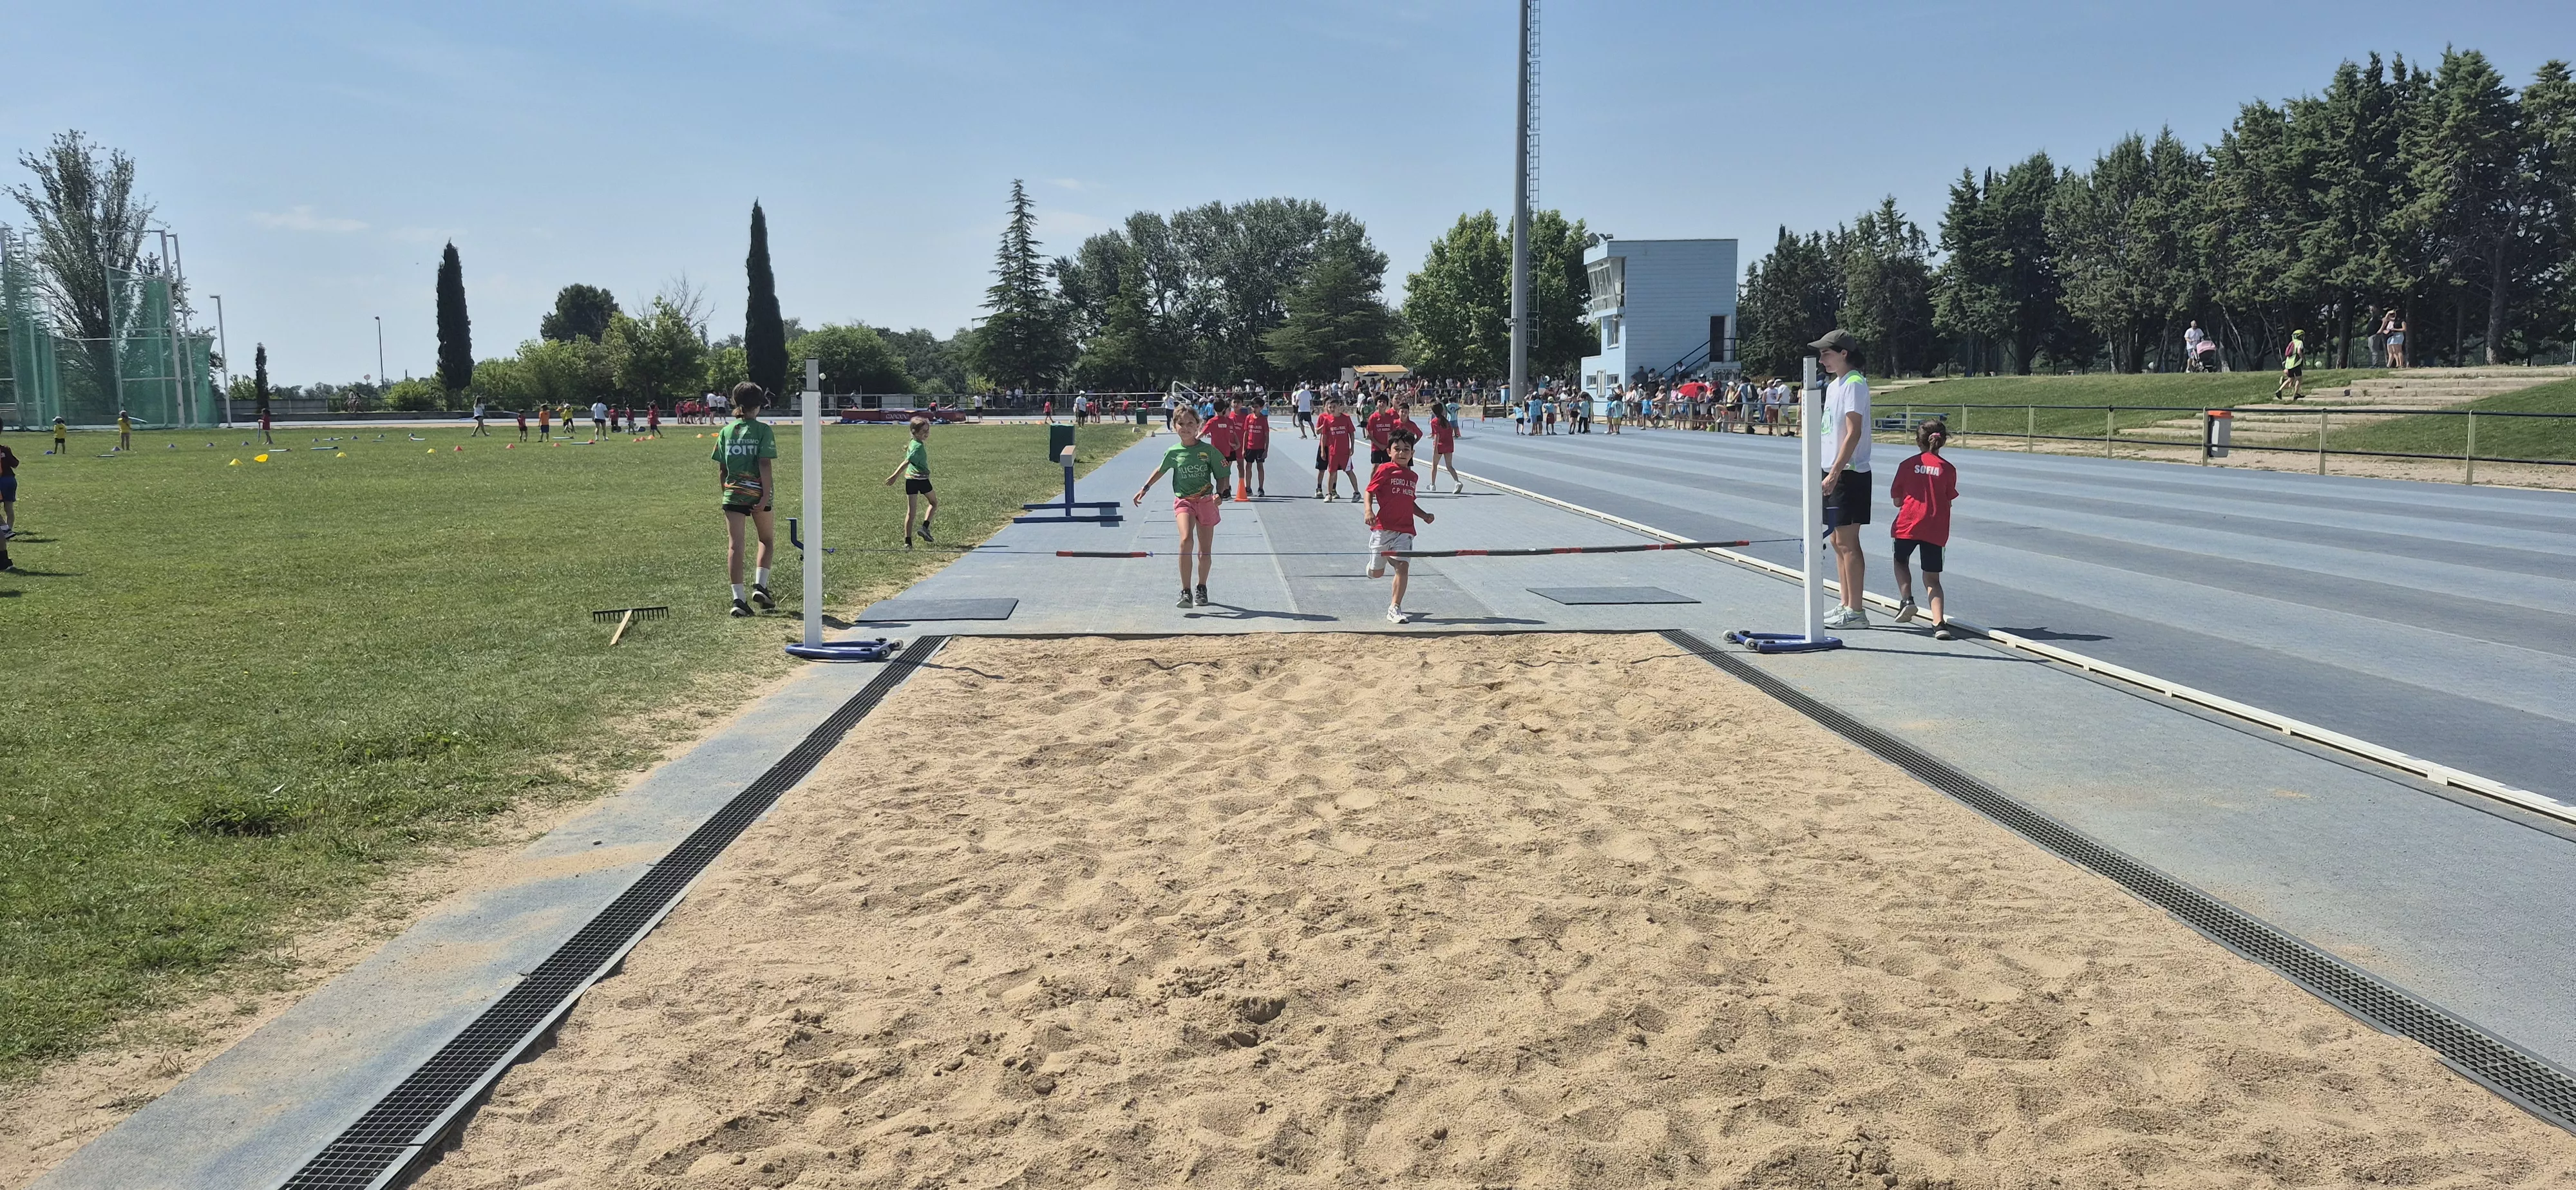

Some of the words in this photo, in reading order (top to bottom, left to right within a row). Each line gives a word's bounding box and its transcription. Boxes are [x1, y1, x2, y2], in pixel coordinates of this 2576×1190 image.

[726, 445, 758, 456] ZOITI
[1914, 464, 1940, 477] SOFIA
[1391, 478, 1405, 486] PEDRO
